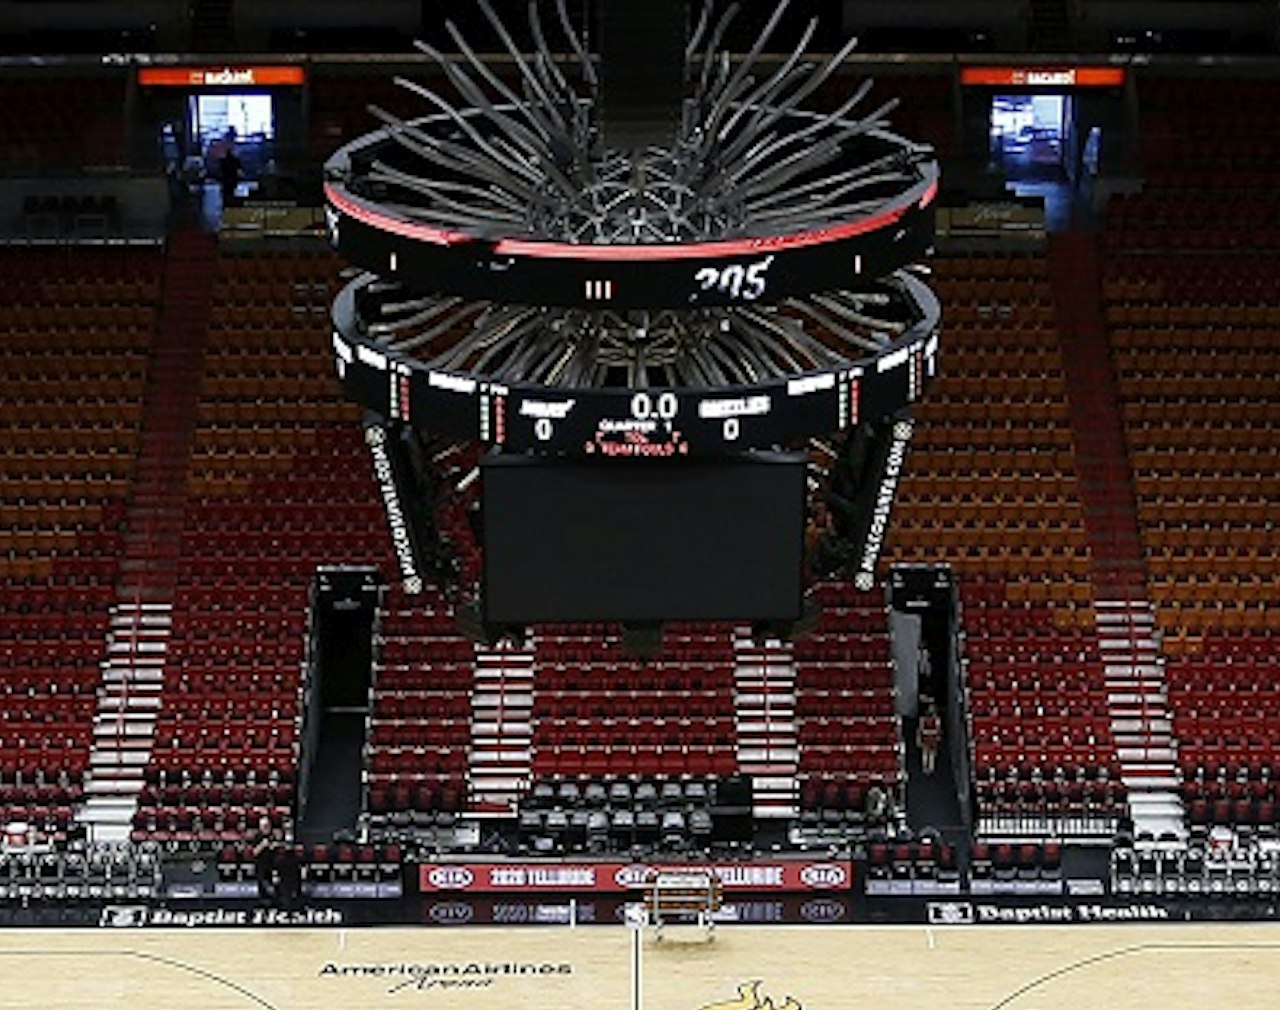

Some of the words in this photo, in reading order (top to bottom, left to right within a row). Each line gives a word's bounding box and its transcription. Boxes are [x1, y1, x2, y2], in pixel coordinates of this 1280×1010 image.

[631, 393, 679, 418] 0.0
[534, 418, 553, 440] 0
[723, 418, 740, 440] 0
[252, 905, 342, 925] Health
[976, 904, 1071, 922] Baptist
[1077, 903, 1169, 920] Health
